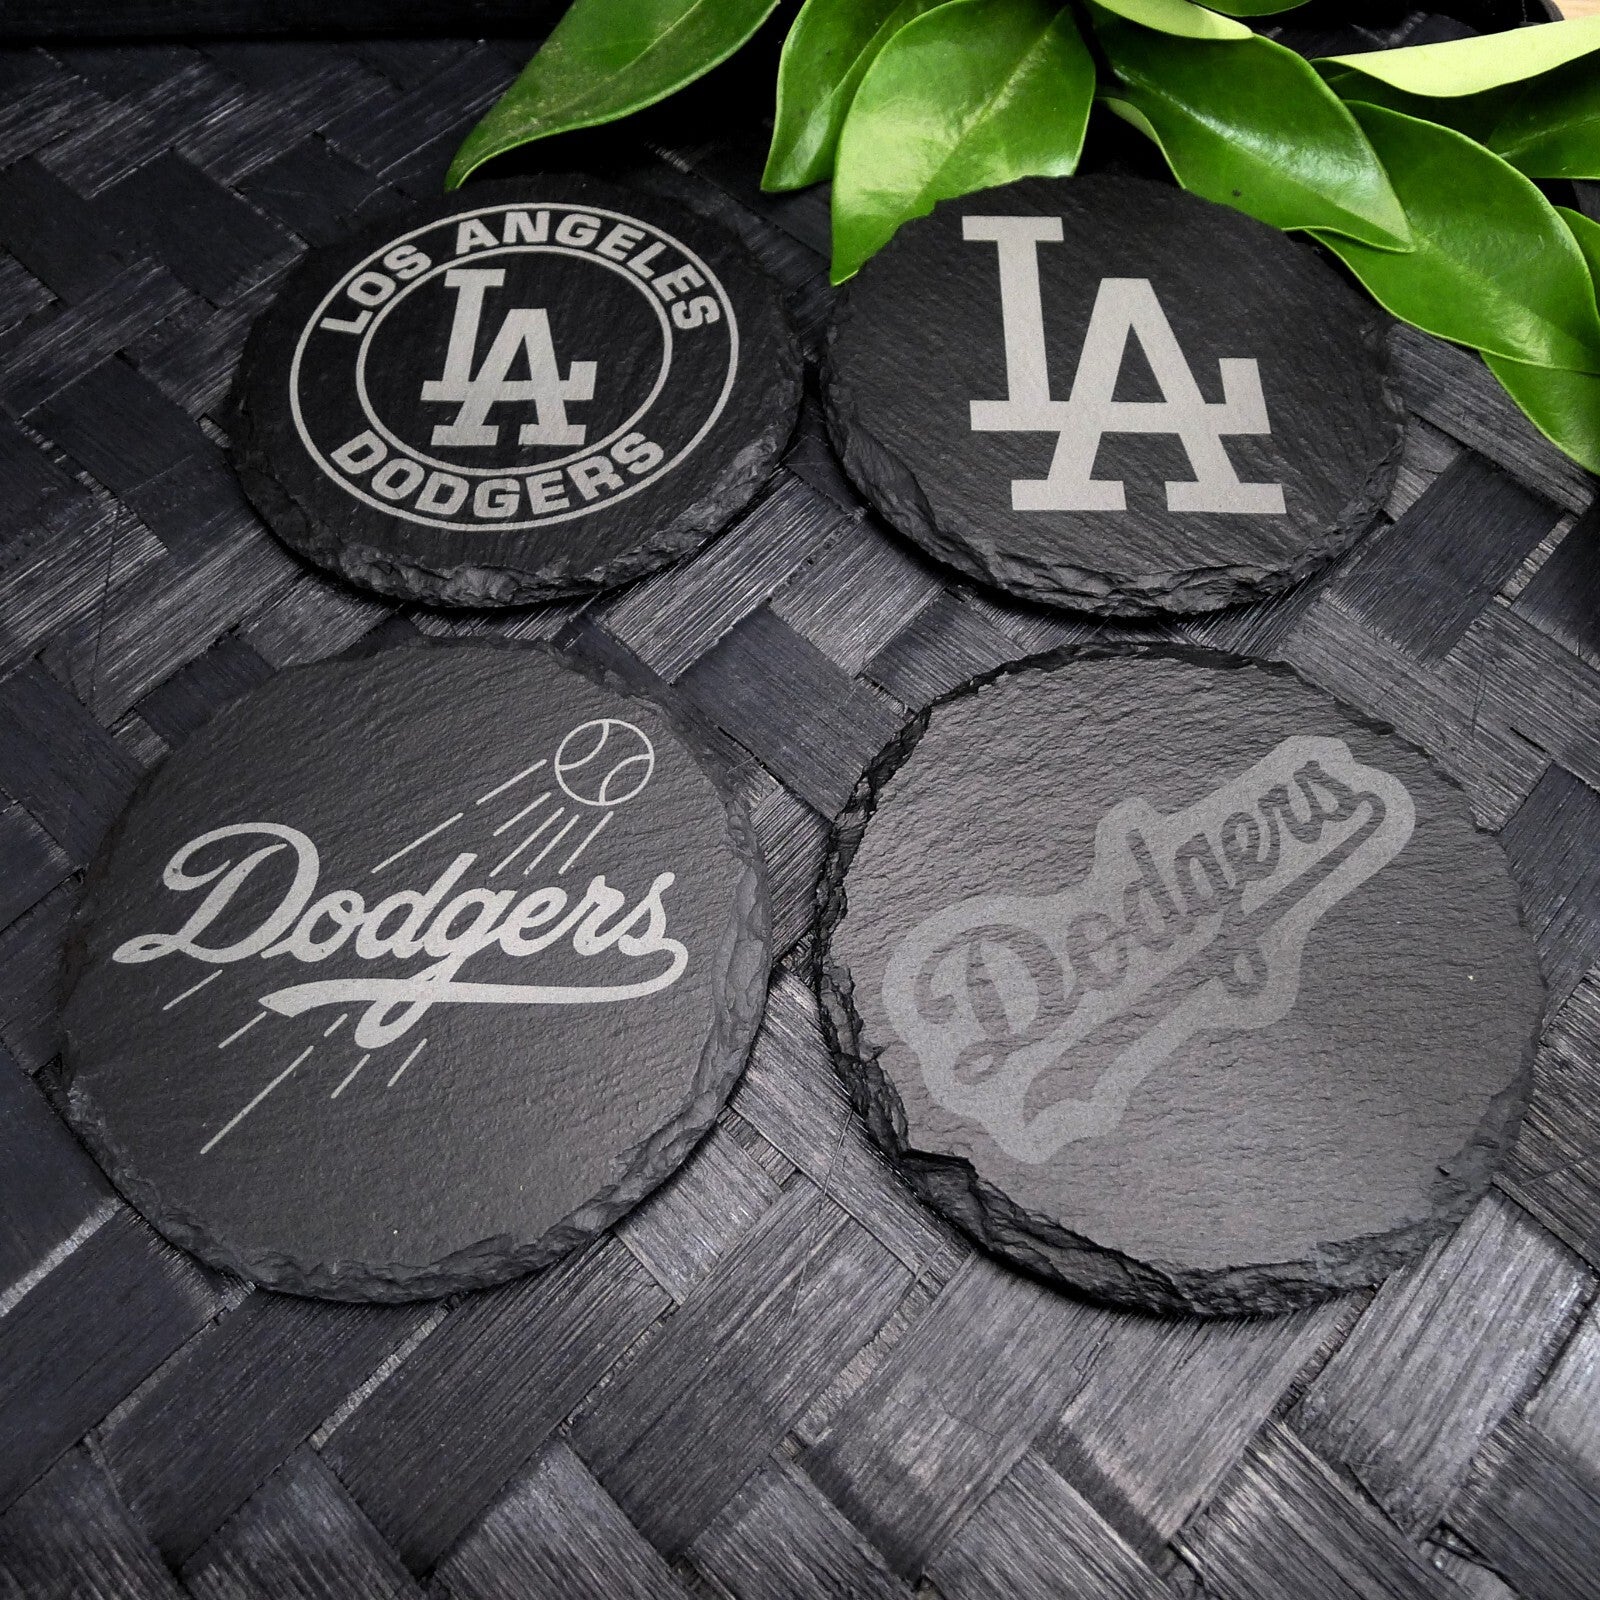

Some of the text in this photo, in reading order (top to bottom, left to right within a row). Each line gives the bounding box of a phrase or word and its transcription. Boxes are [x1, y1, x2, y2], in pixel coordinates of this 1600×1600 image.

[319, 210, 720, 334] LOS ANGELES
[420, 267, 598, 446] LA
[962, 215, 1287, 514] LA
[330, 428, 664, 518] DODGERS
[112, 820, 688, 1048] Dodgers
[915, 760, 1386, 1122] Dodgers
